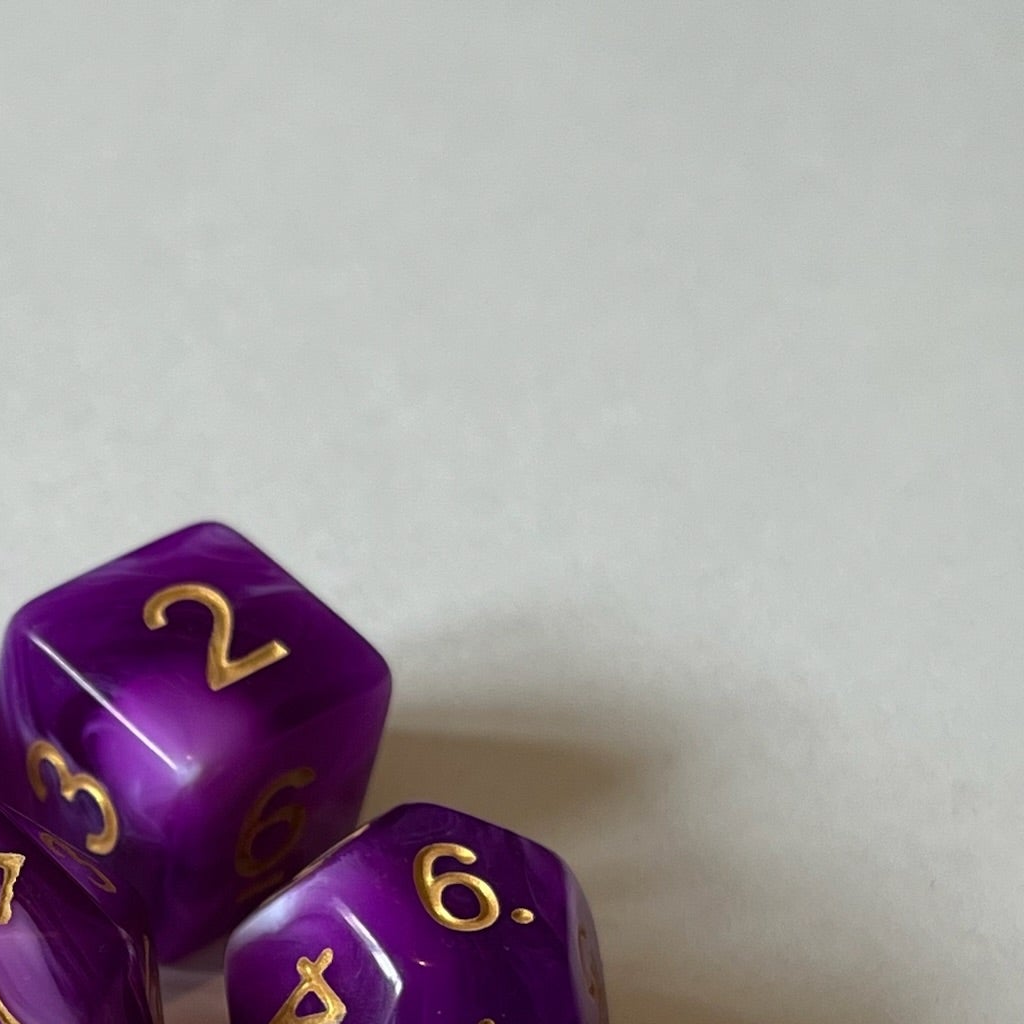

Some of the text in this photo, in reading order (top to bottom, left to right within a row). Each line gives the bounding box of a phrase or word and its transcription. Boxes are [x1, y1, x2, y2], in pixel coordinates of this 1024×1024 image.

[142, 582, 291, 692] 2
[26, 739, 119, 856] 3
[235, 766, 316, 878] 6
